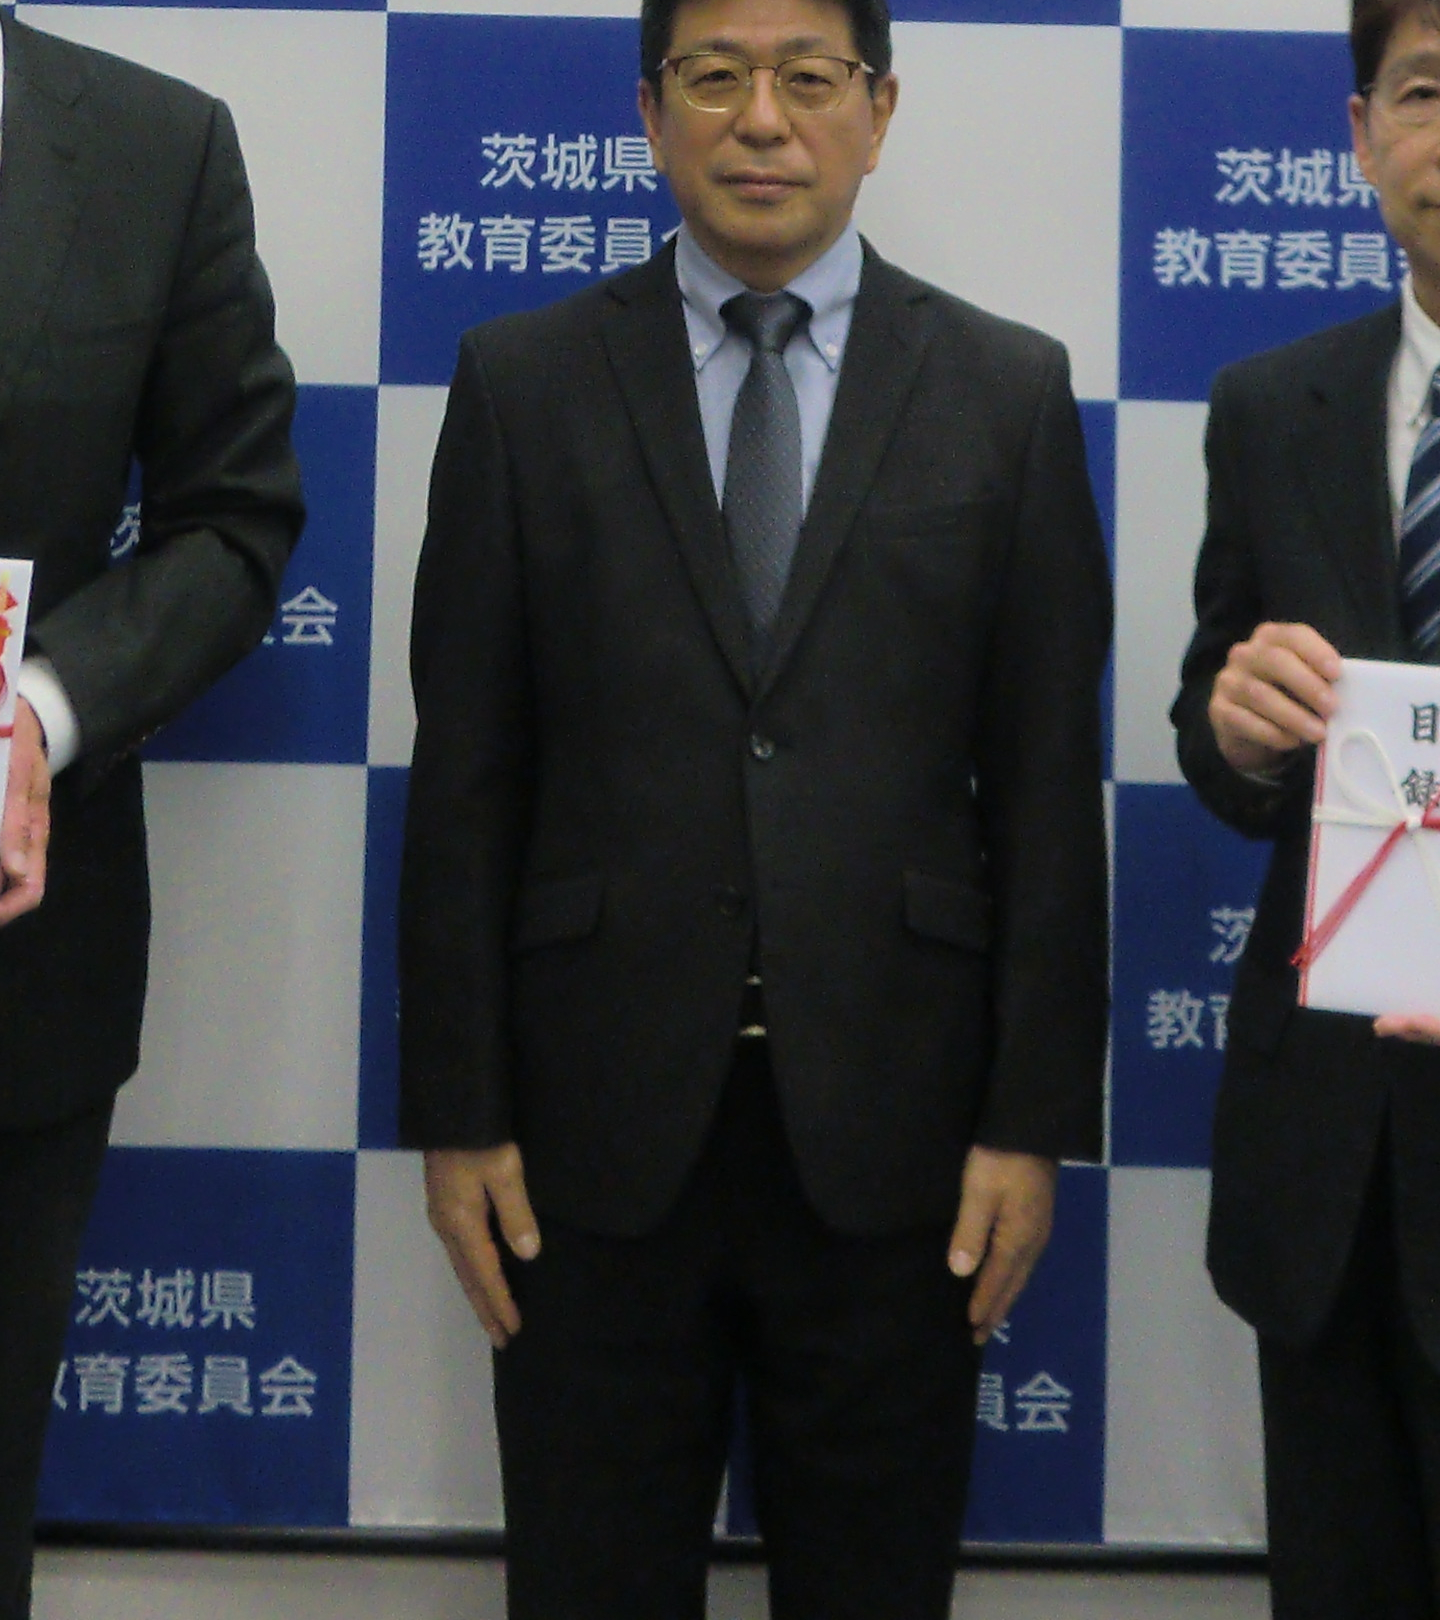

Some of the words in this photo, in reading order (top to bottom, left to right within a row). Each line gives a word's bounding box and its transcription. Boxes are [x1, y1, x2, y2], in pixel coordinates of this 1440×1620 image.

[480, 131, 657, 192] 茨城県
[417, 212, 683, 274] 教育委員
[1153, 227, 1410, 292] 教育委員
[75, 1267, 256, 1330] 茨城県
[53, 1352, 318, 1417] 育委員会
